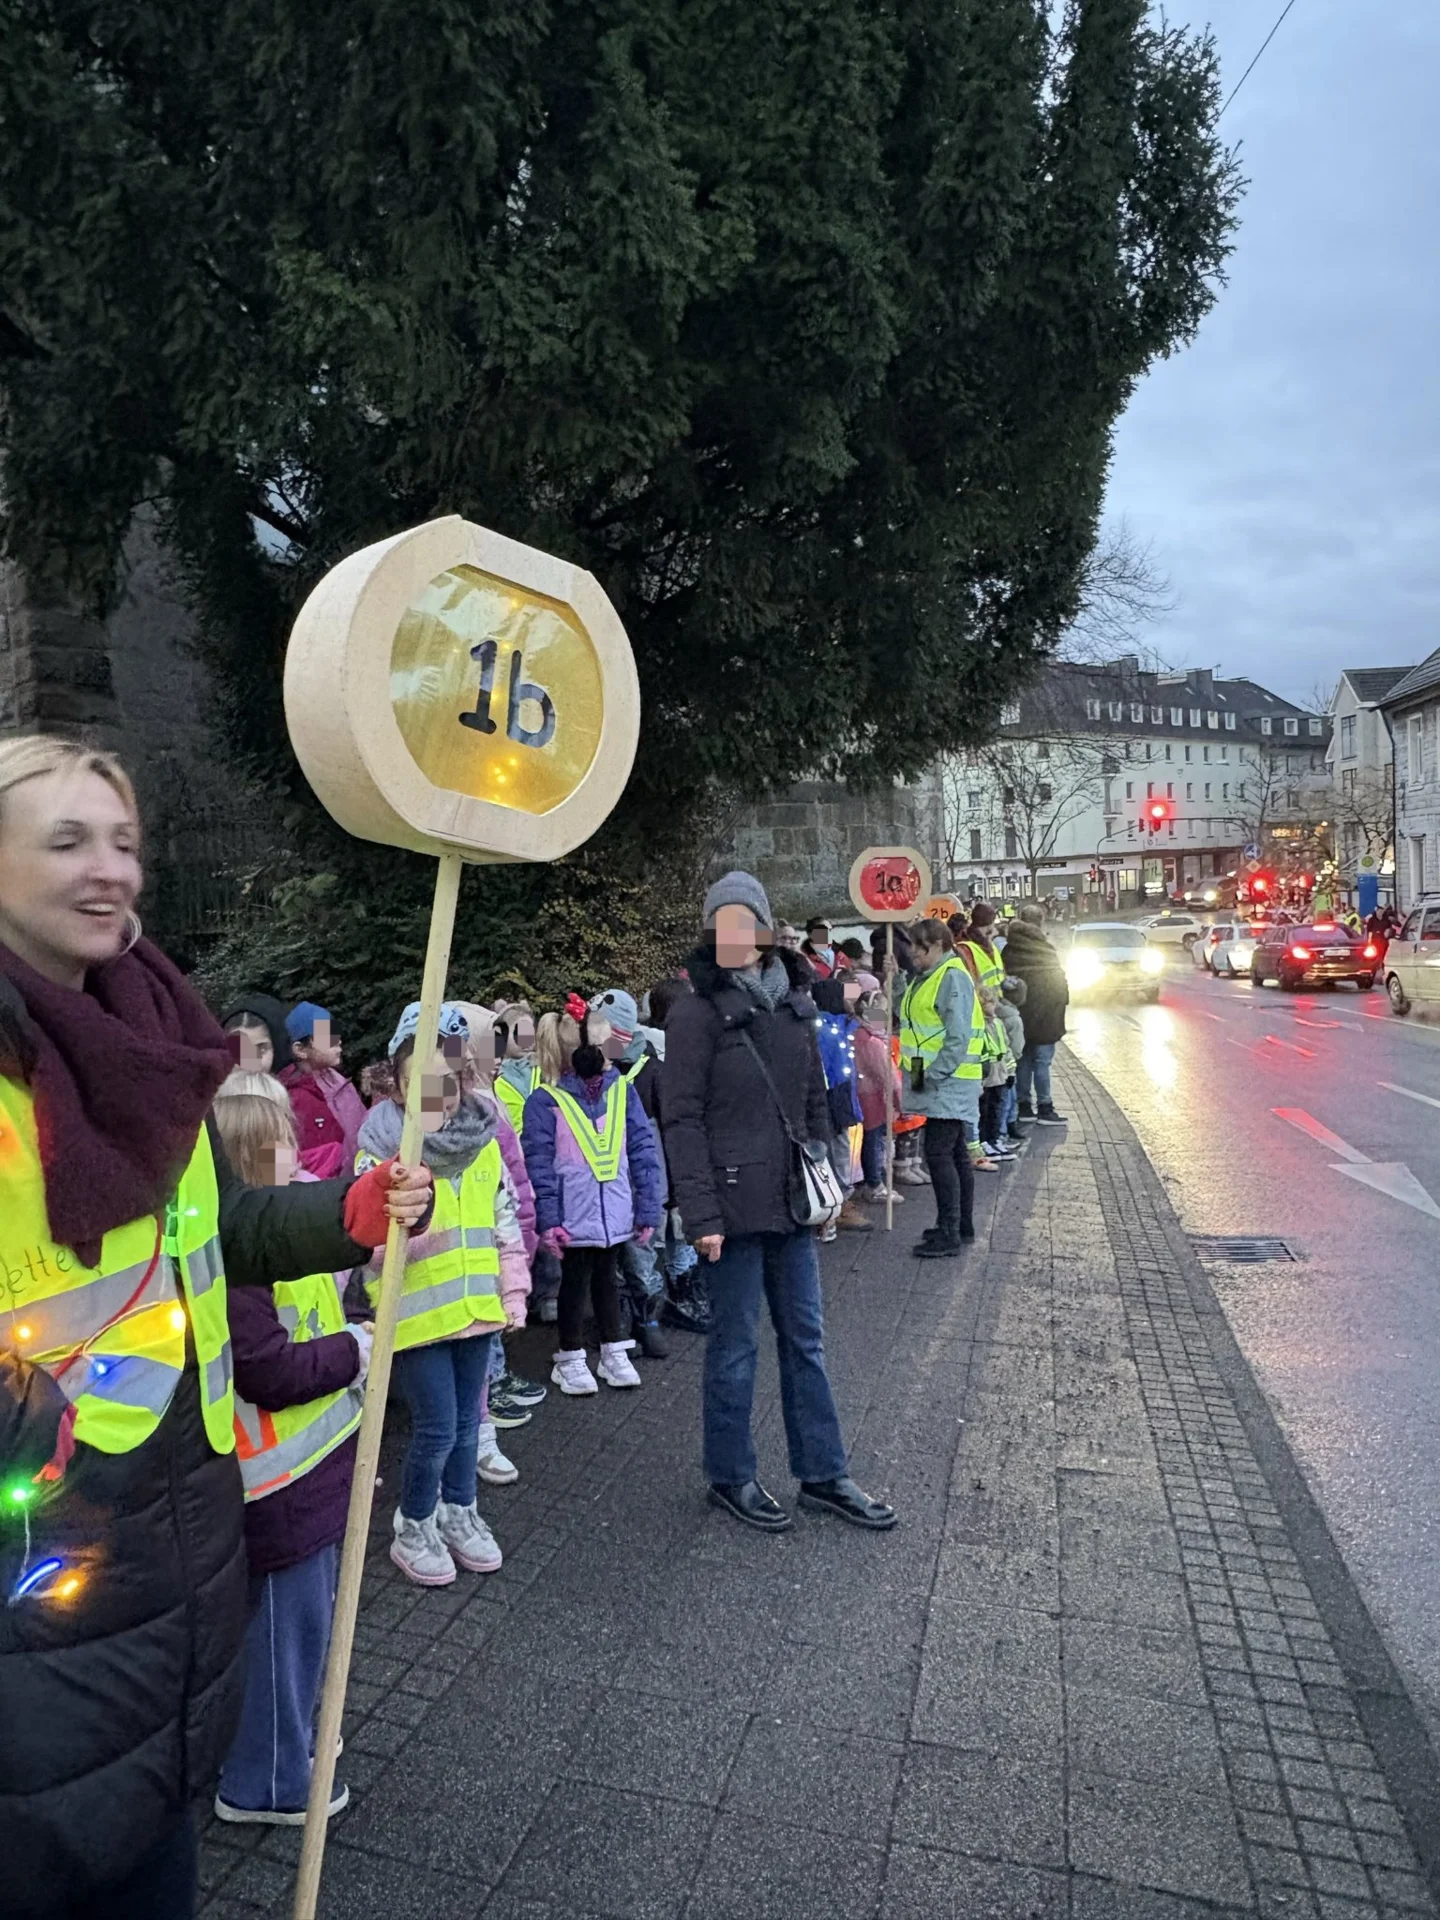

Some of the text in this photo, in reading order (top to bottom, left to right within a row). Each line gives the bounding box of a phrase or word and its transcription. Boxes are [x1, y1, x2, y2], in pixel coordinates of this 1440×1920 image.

[458, 639, 557, 748] 1b
[875, 871, 903, 893] 1a
[930, 907, 949, 919] 2b
[0, 1245, 75, 1299] ette
